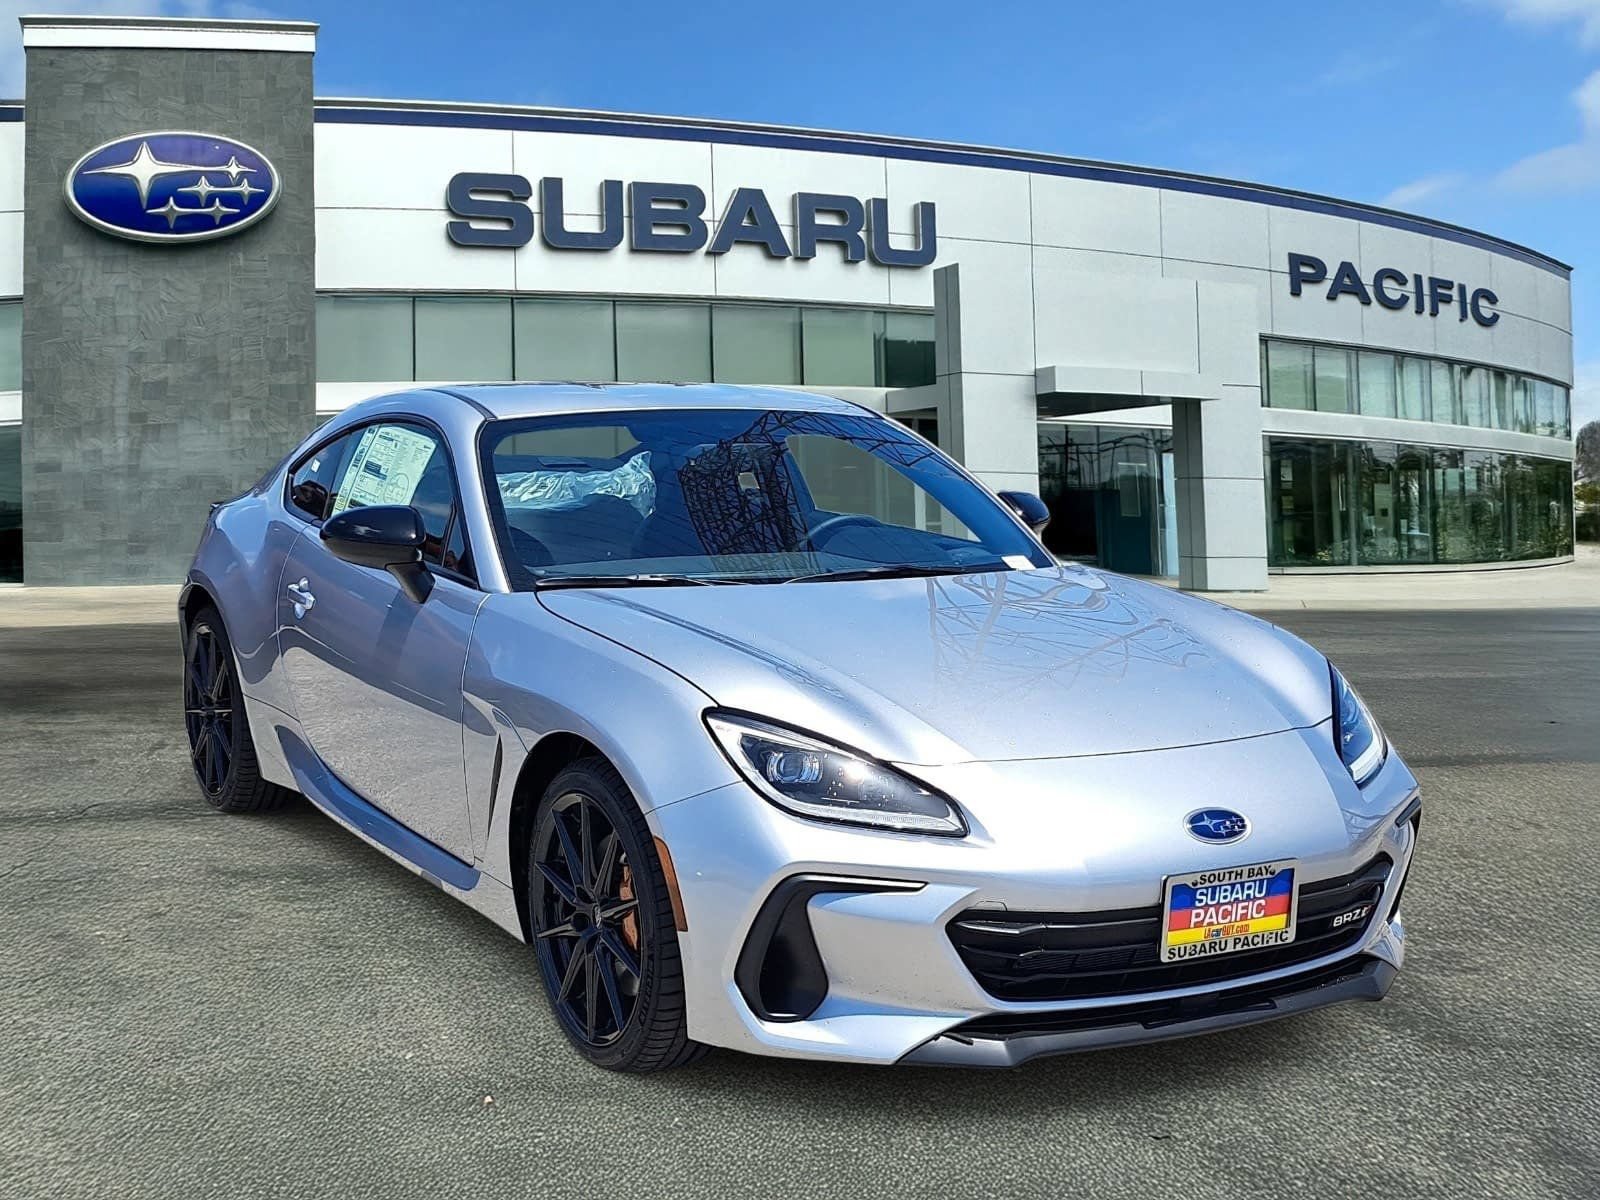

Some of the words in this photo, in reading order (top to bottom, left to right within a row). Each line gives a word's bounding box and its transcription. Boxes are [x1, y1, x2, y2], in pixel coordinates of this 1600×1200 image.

[446, 171, 938, 269] SUBARU
[1287, 252, 1500, 328] PACIFIC
[1199, 870, 1243, 886] SOUTH
[1247, 864, 1272, 880] BAY
[1195, 879, 1267, 907] SUBARU
[1190, 899, 1266, 928] PACIFIC
[1167, 939, 1228, 961] SUBARU
[1232, 930, 1289, 951] PACIFIC
